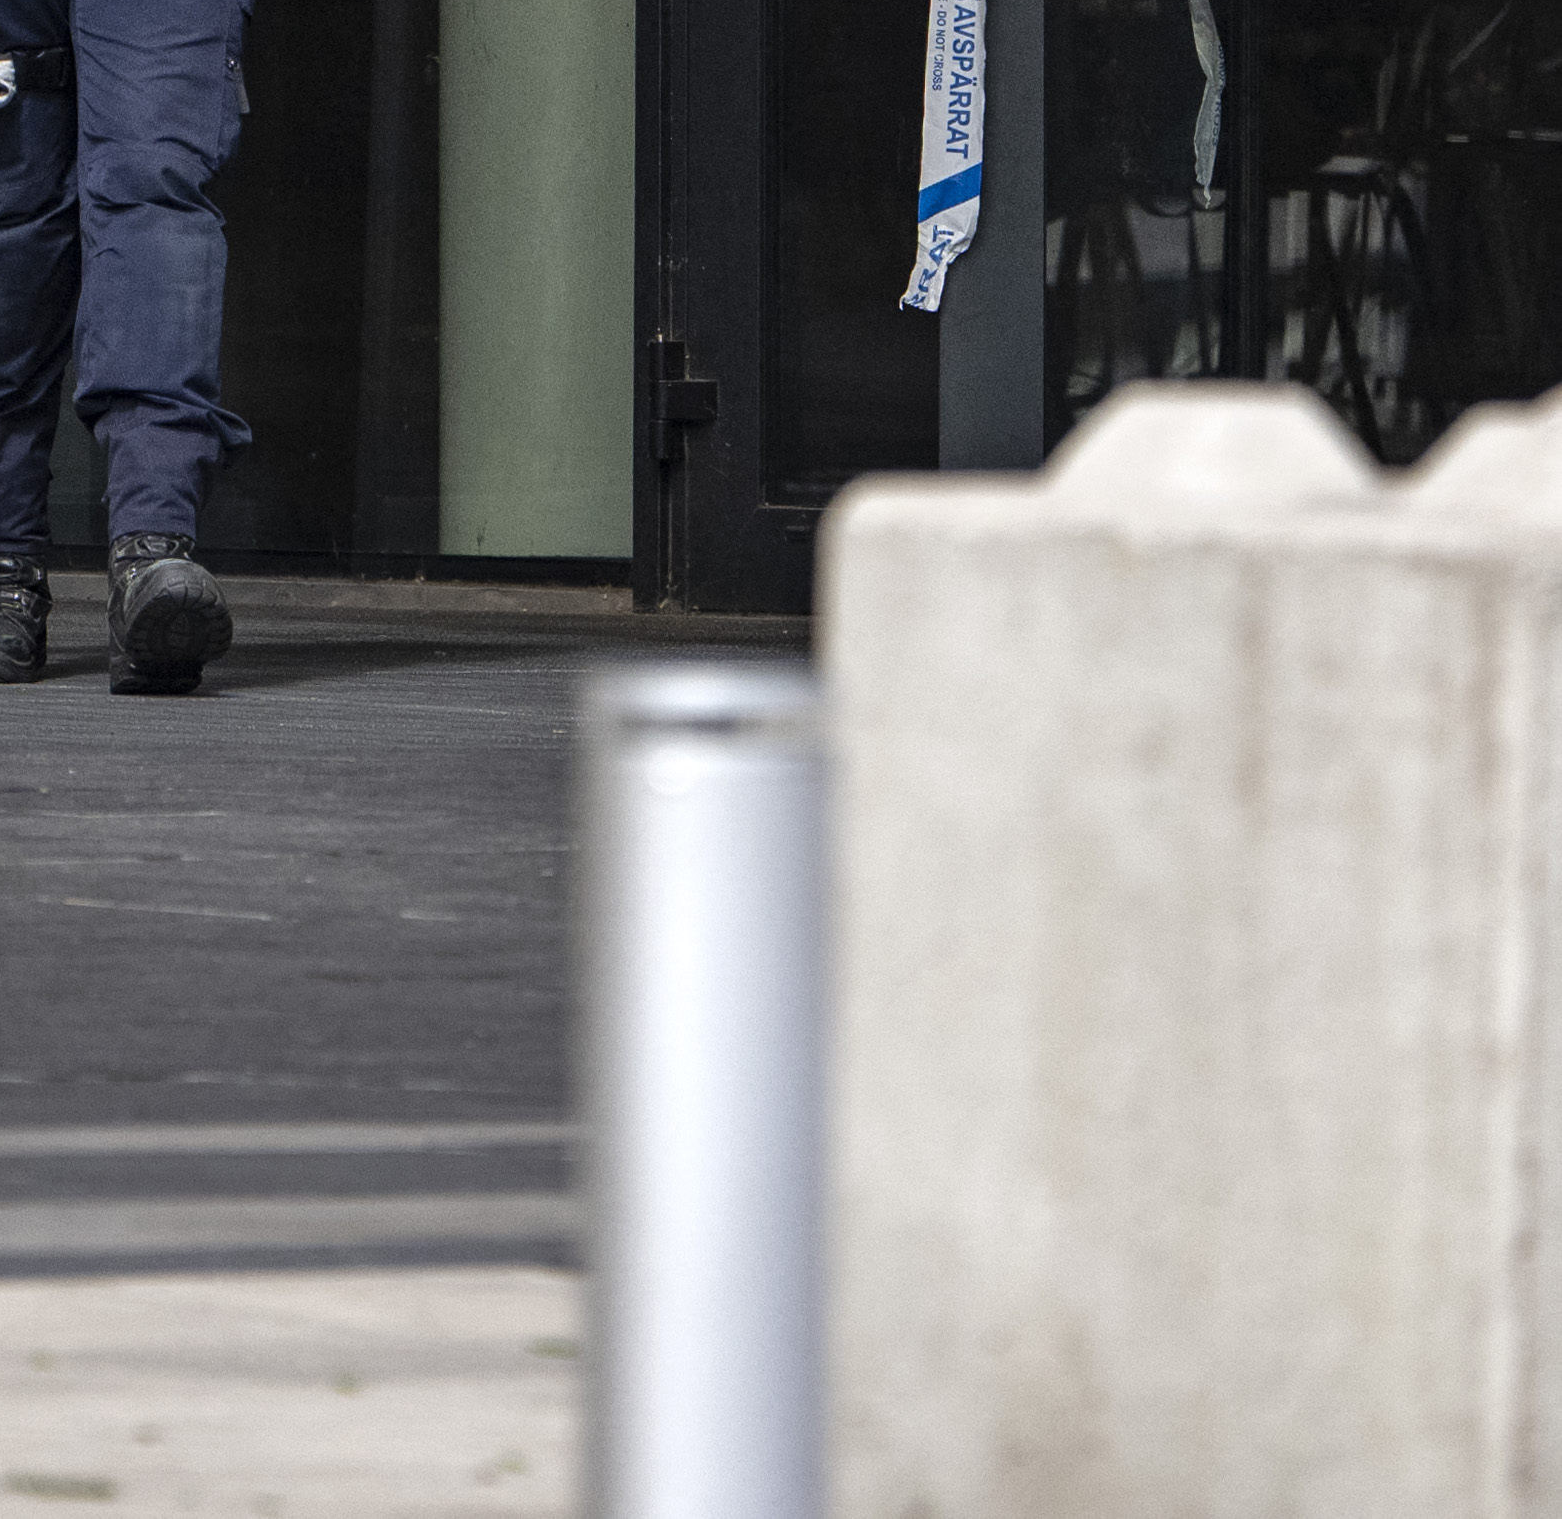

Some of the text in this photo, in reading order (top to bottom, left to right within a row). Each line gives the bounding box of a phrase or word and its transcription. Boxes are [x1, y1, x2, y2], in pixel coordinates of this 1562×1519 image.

[935, 10, 948, 28] DO
[934, 28, 947, 51] NOT
[931, 54, 945, 92] CROSS
[945, 4, 978, 160] AVSPÄRRAT
